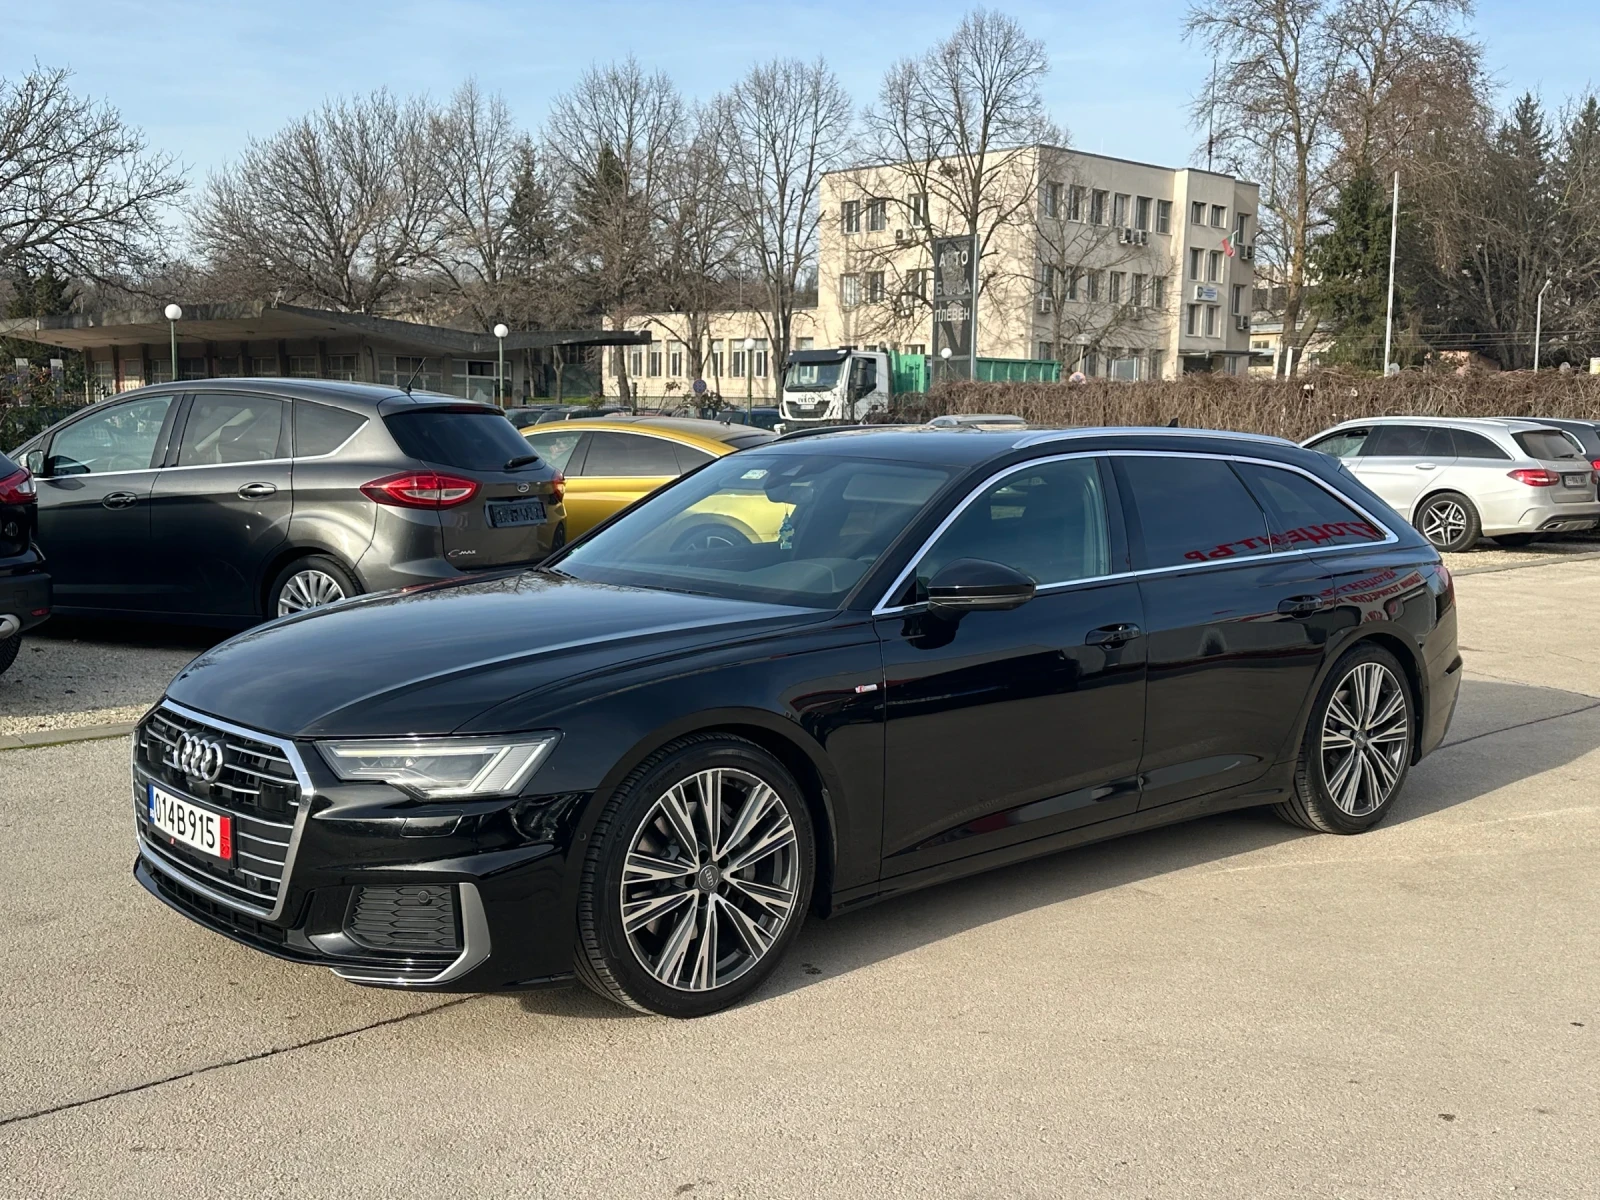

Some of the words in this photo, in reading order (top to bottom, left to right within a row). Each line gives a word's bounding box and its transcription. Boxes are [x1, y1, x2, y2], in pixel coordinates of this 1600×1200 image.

[938, 250, 969, 267] АТО
[936, 279, 971, 296] БСА
[934, 307, 970, 322] ПЛЕВЕН
[155, 793, 215, 849] 014B915
